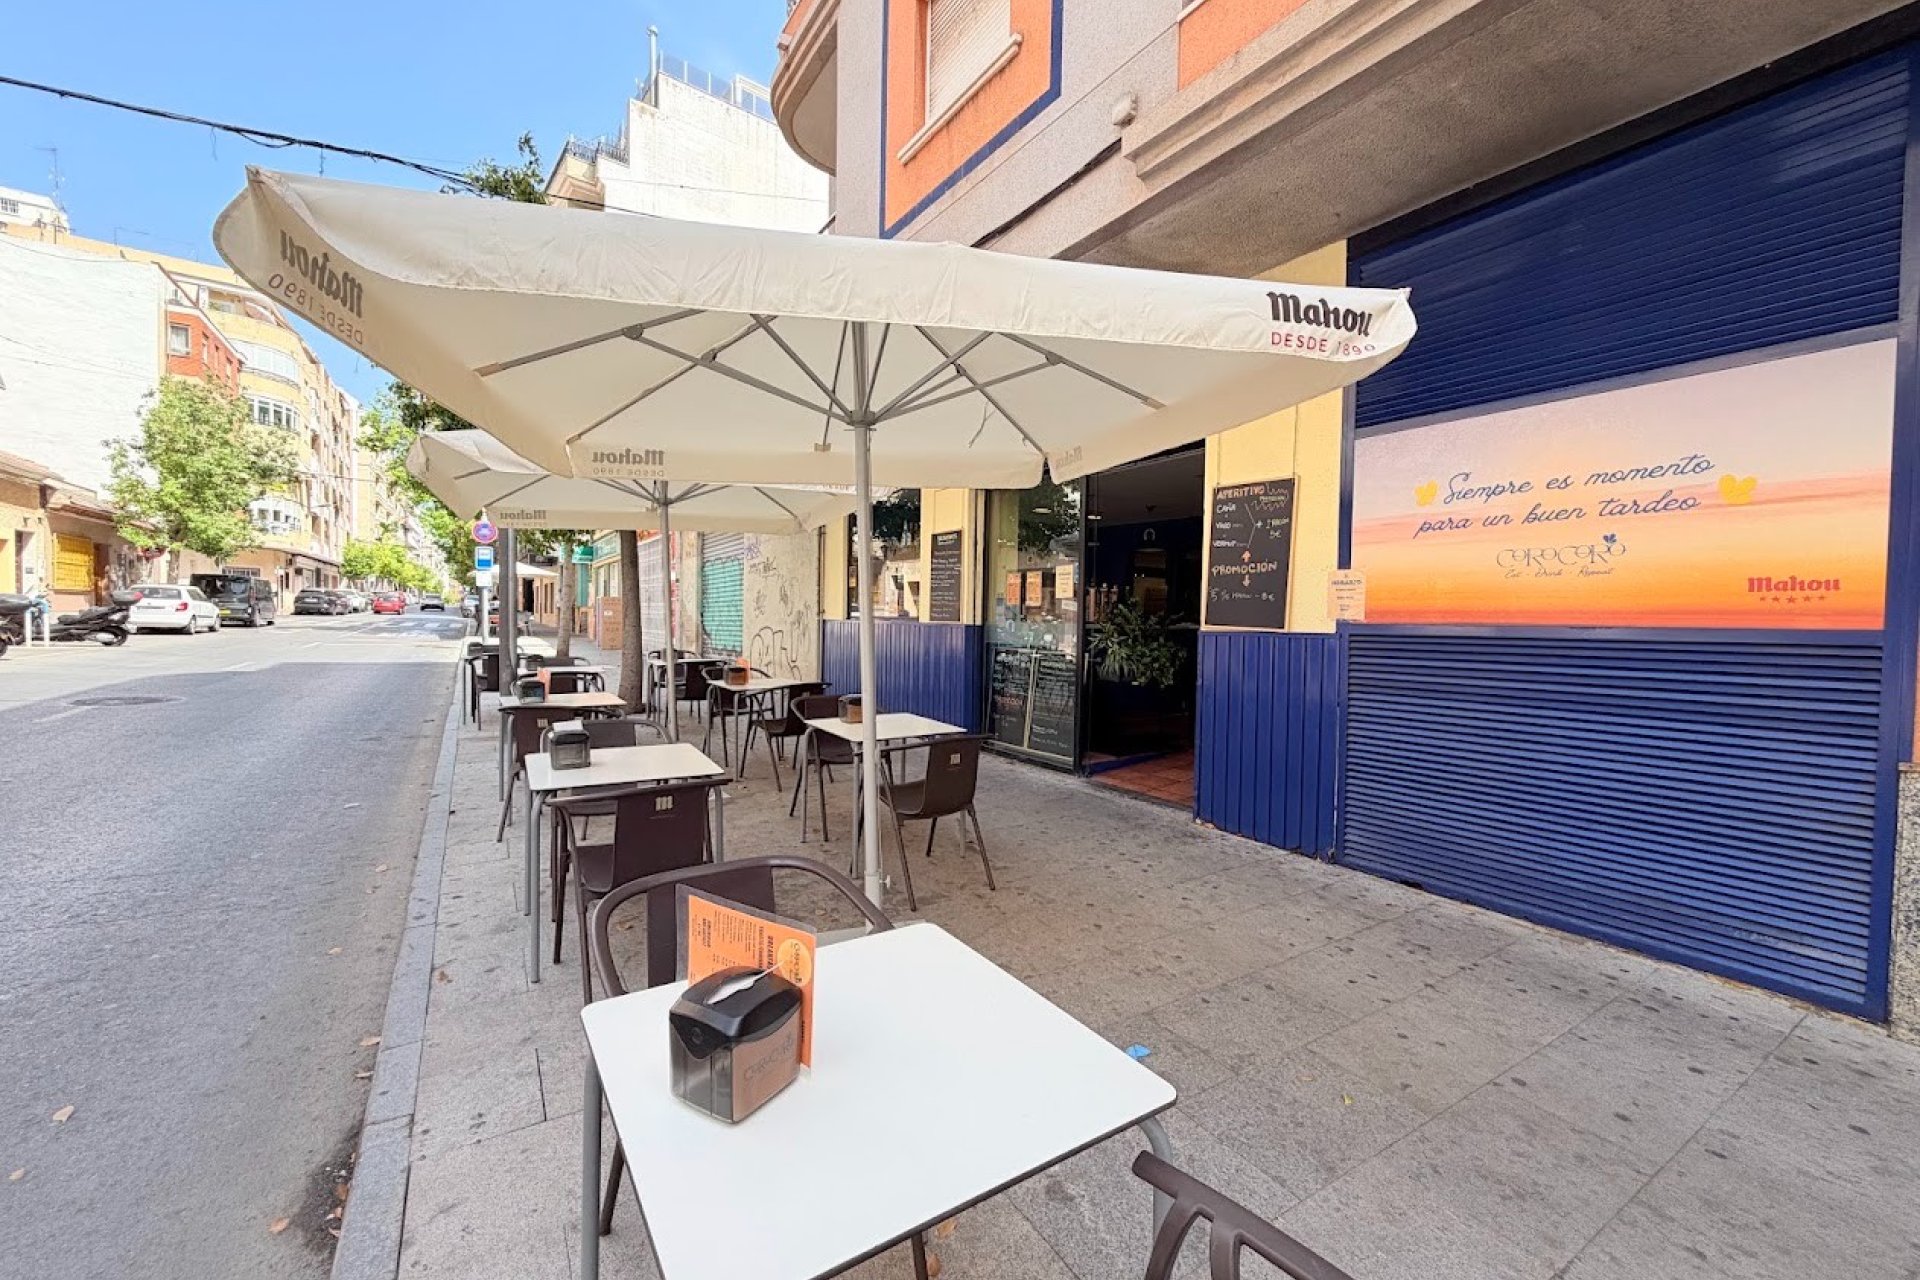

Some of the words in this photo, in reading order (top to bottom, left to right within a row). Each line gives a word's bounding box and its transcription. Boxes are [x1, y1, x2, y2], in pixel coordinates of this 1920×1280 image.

[1266, 291, 1373, 337] Mahou
[1271, 331, 1328, 353] DESDE
[1443, 472, 1534, 505] Siempre
[1546, 475, 1575, 490] es
[1584, 454, 1715, 487] momento
[1413, 516, 1473, 539] para
[1482, 513, 1514, 529] un
[1521, 503, 1586, 525] buen
[1598, 490, 1701, 518] tardeo
